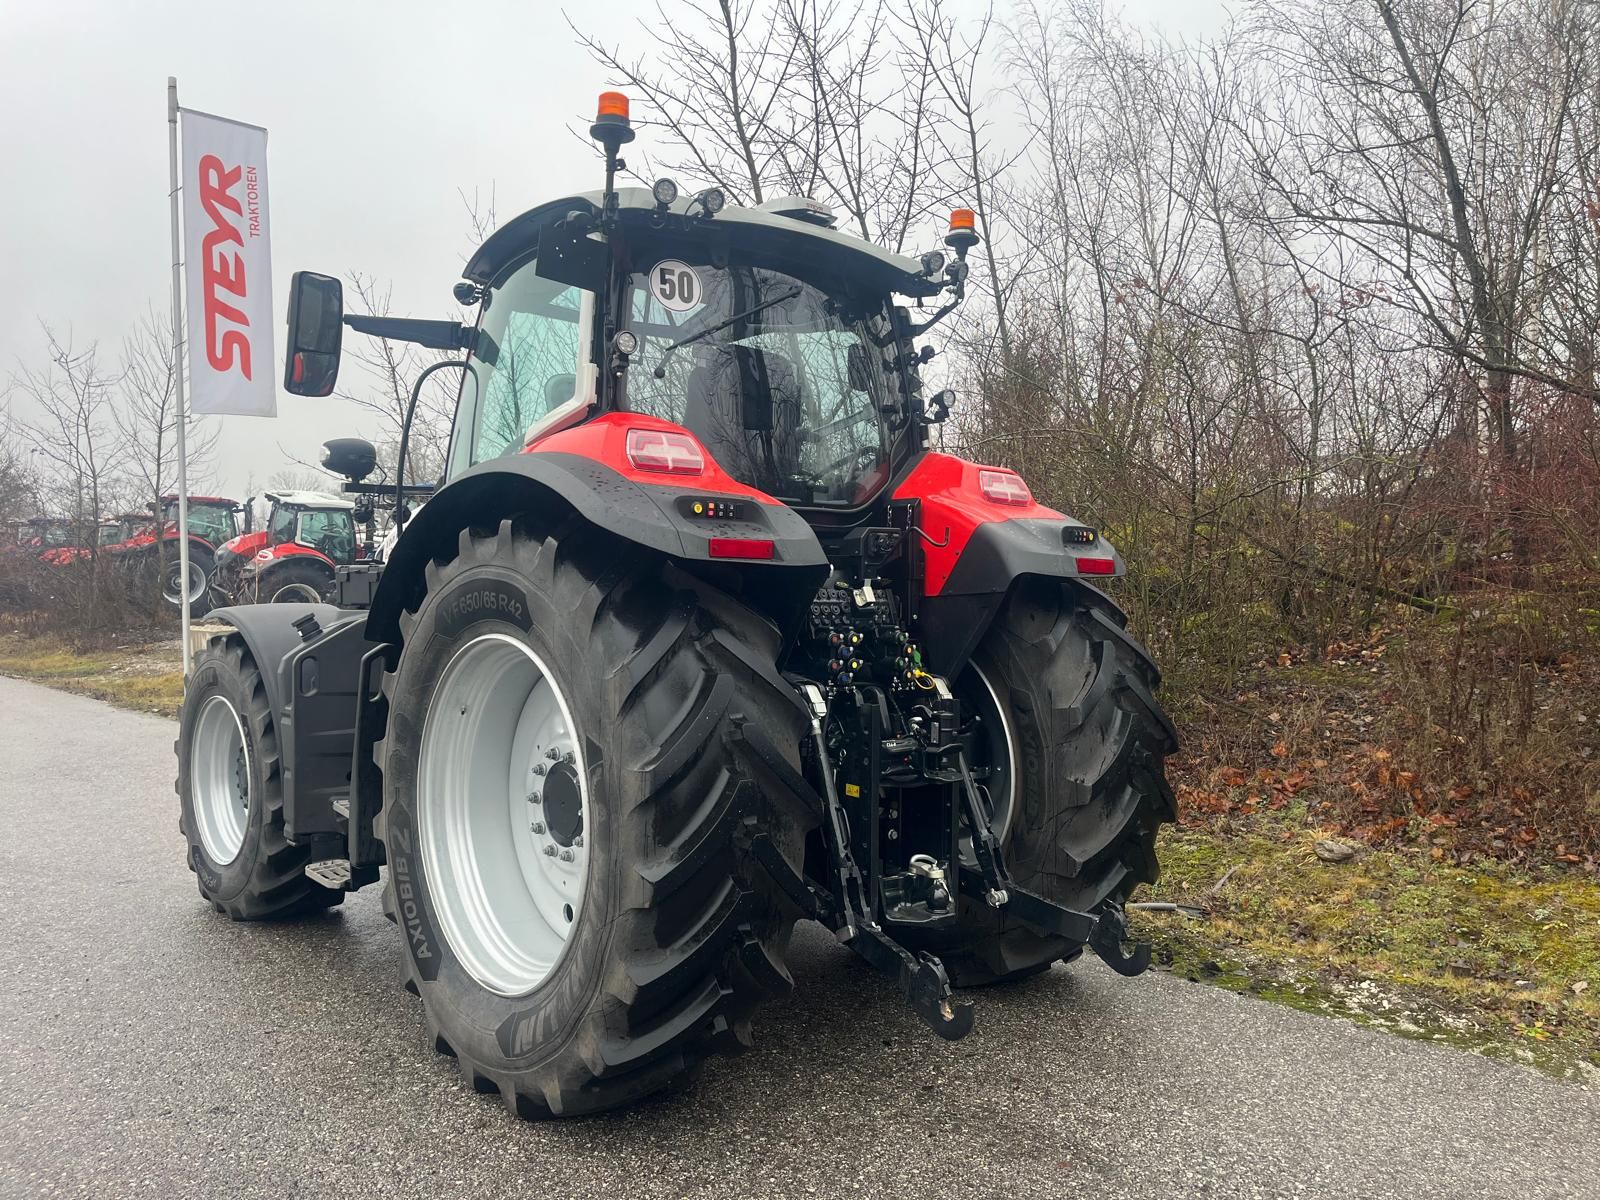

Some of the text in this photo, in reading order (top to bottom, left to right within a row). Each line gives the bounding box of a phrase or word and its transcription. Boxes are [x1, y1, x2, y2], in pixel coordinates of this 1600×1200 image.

[247, 166, 260, 238] TRAKTOREN
[199, 154, 252, 382] STEYR
[659, 267, 694, 304] 50
[396, 857, 433, 959] AXIOBIB
